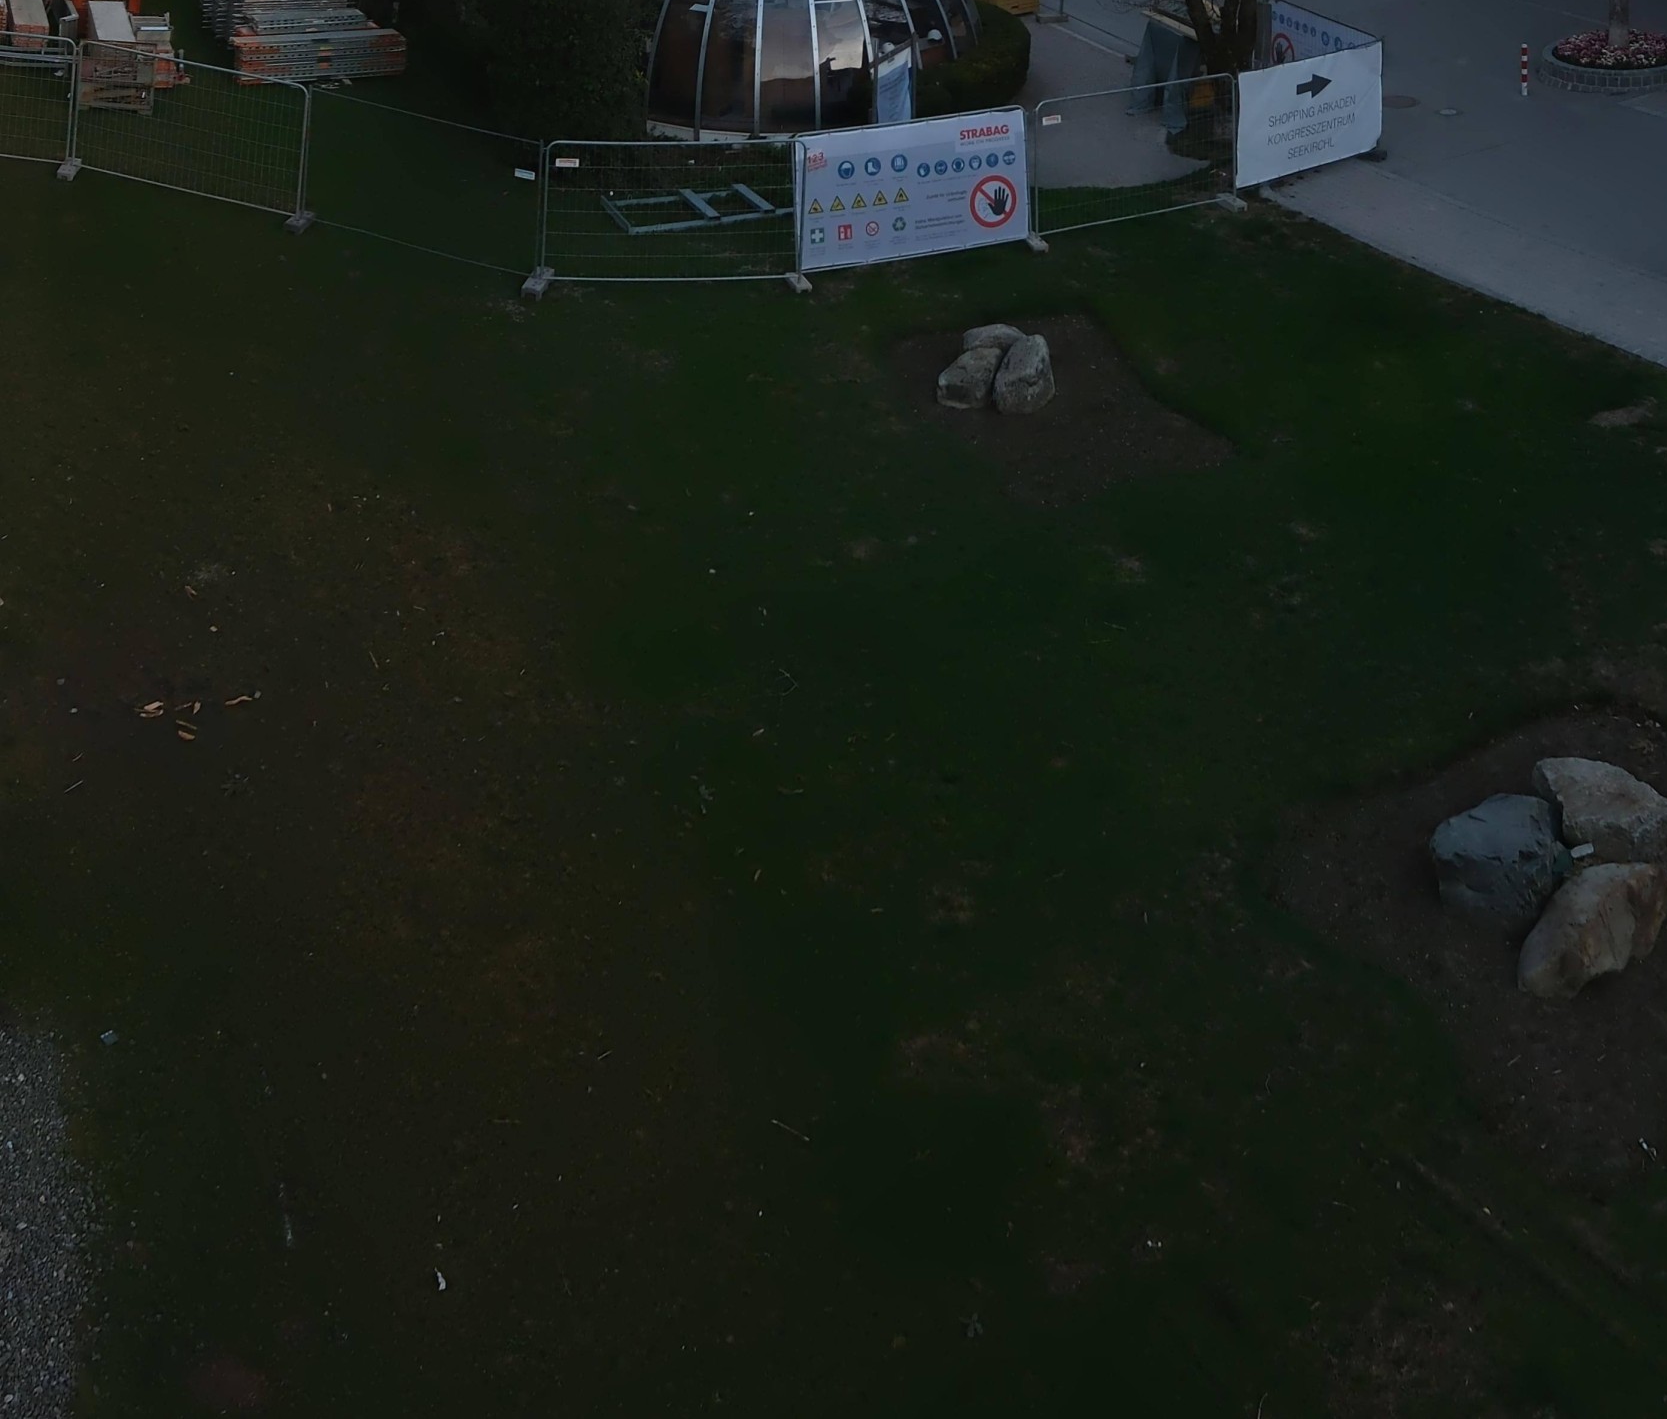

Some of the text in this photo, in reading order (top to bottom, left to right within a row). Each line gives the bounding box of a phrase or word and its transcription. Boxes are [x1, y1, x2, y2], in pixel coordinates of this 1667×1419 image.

[1268, 94, 1356, 128] SHOPPING ARKADEN
[960, 124, 1010, 141] STRABAG
[1267, 112, 1355, 146] KONGRESSZENTRUM
[1287, 138, 1335, 159] SEEKIRCHL
